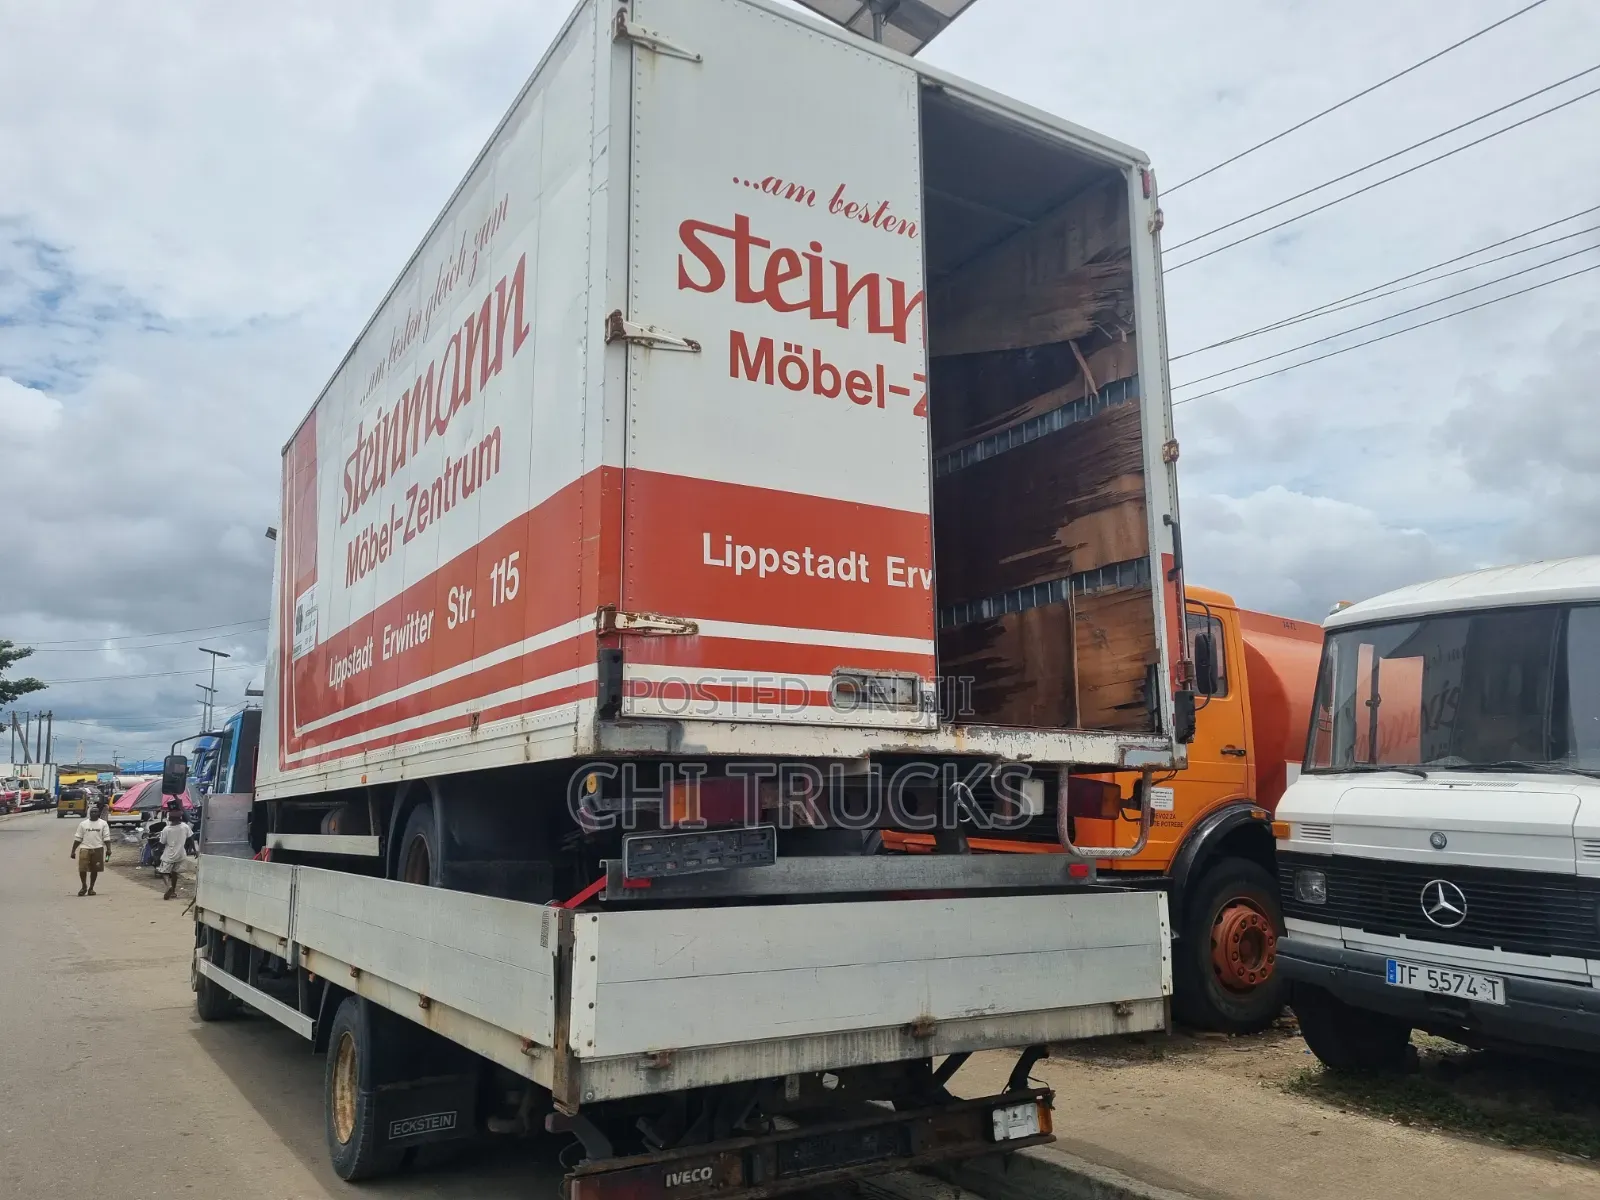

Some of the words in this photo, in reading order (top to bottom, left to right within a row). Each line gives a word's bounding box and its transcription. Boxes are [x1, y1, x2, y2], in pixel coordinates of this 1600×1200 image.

[828, 183, 919, 239] besten
[345, 425, 502, 590] Möbel-Zentrum
[702, 532, 870, 583] Lippstadt
[328, 640, 374, 690] Lippstadt
[382, 607, 435, 660] Erwitter
[447, 586, 475, 629] Str.
[490, 551, 520, 608] 115
[1397, 964, 1419, 985] TF
[1427, 970, 1478, 996] 5574
[1484, 978, 1499, 1000] T
[393, 1113, 452, 1136] ECKSTEIN
[665, 1166, 713, 1188] IVECO
